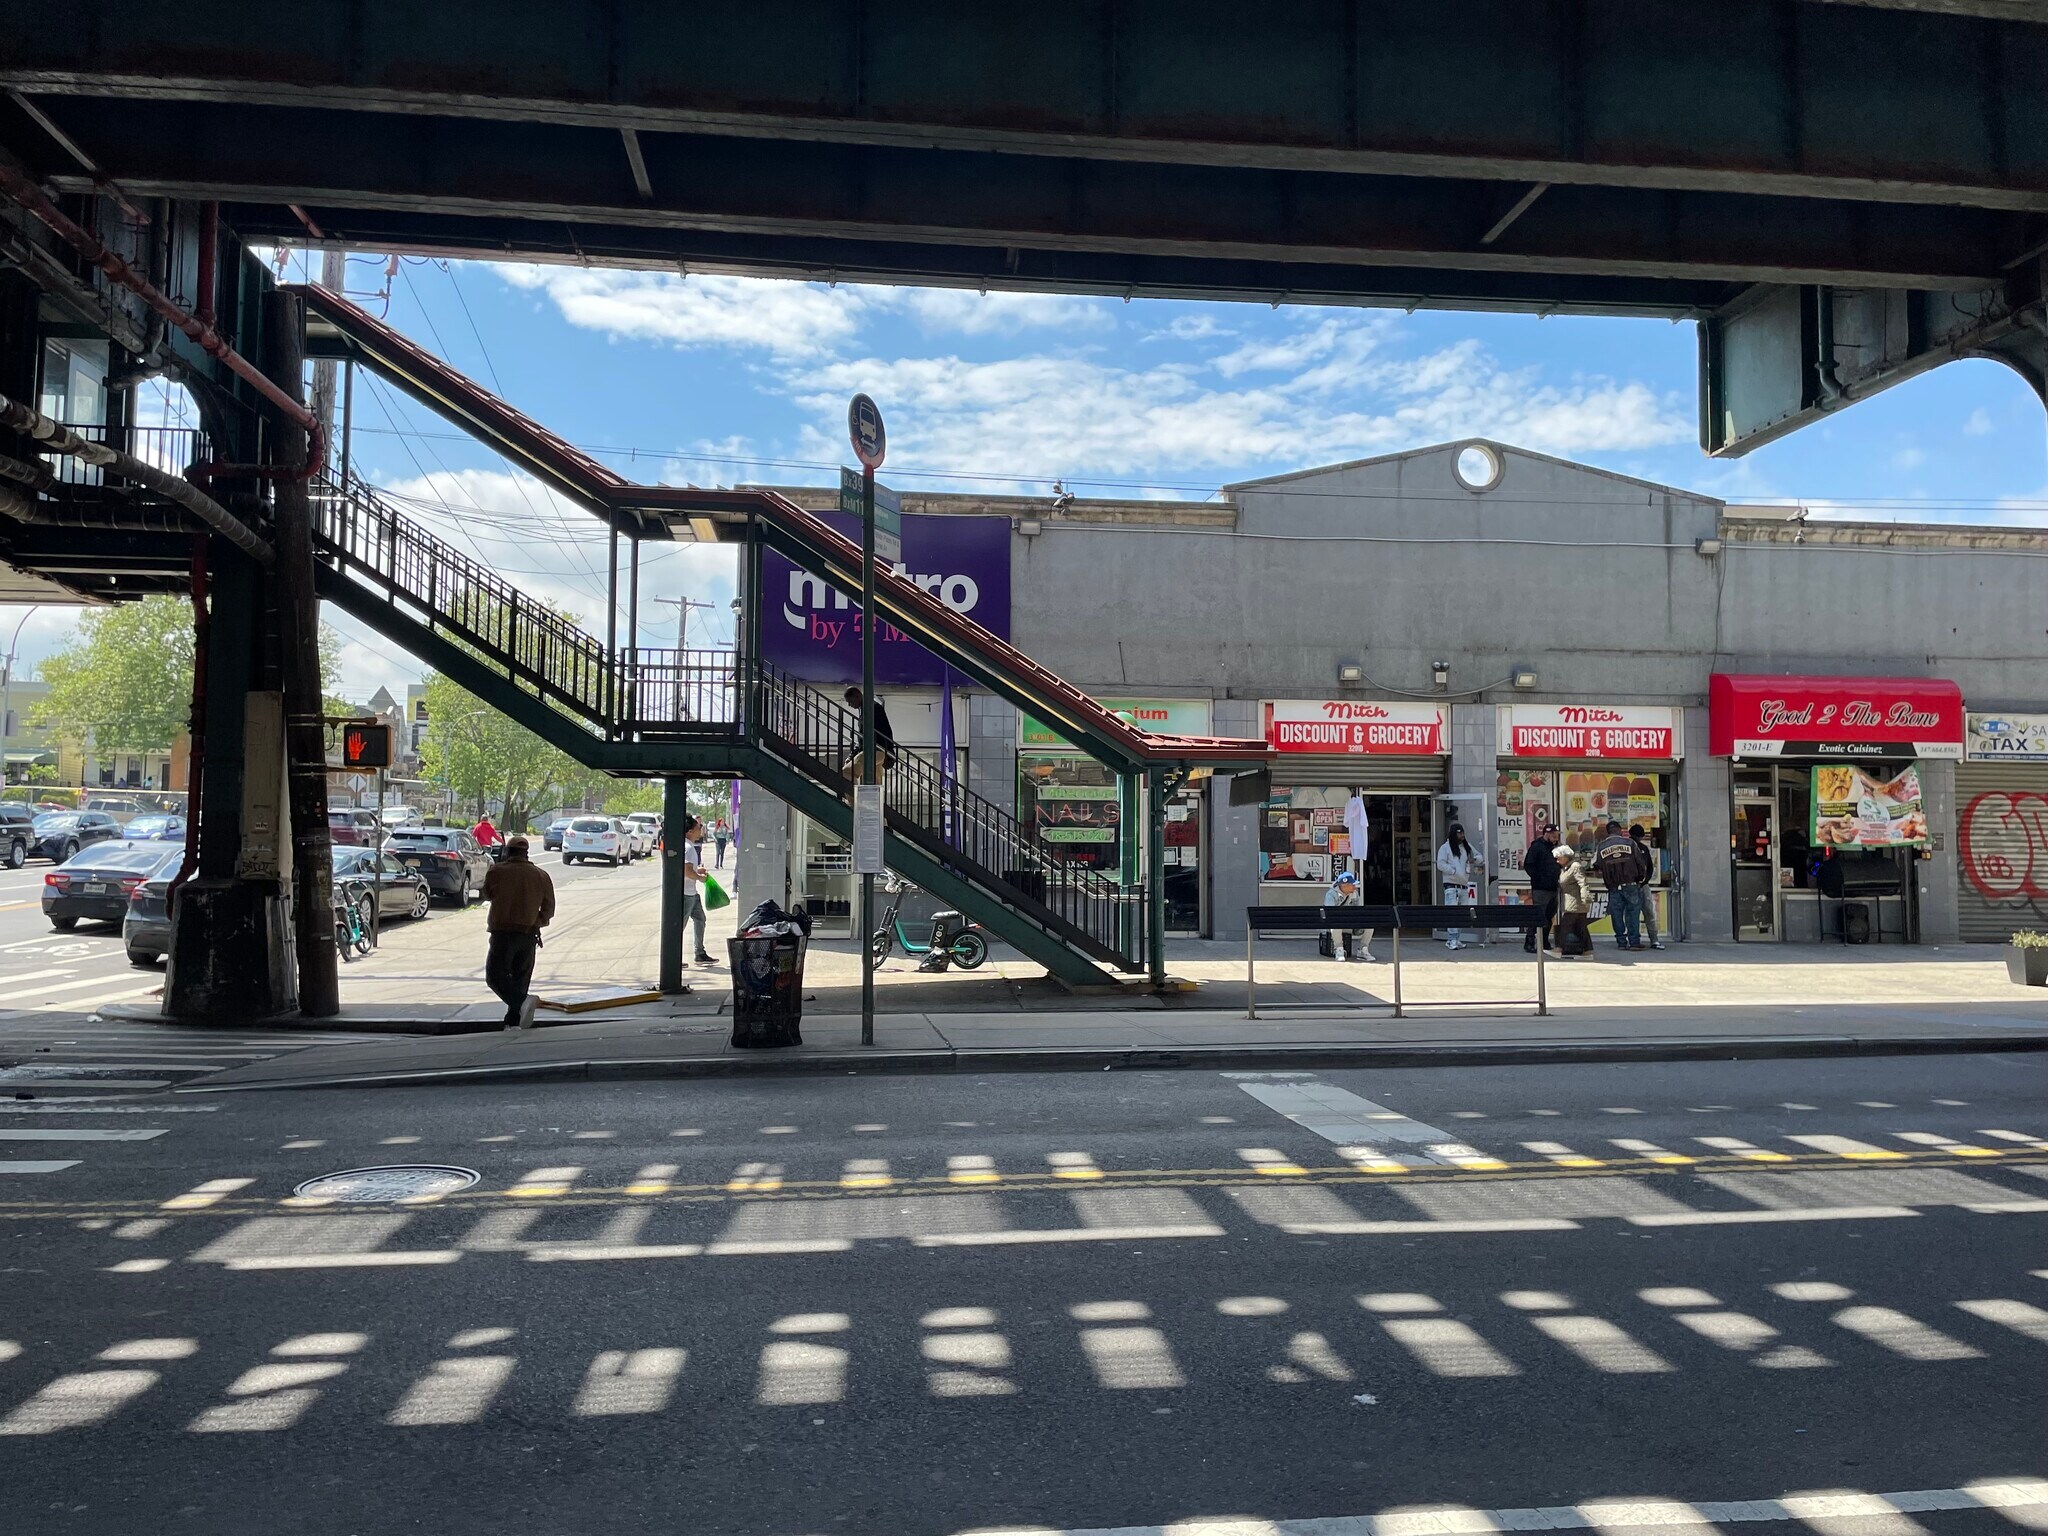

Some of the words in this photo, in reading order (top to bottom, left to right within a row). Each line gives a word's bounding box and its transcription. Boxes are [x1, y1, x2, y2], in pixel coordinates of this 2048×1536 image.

[843, 473, 863, 493] Bx39
[843, 495, 864, 515] BxM11
[811, 614, 846, 648] by
[1323, 702, 1389, 719] Mitch
[1559, 706, 1623, 723] Mitch
[1758, 700, 1814, 733] Good
[1817, 704, 1836, 724] 2
[1841, 701, 1881, 726] The
[1885, 701, 1939, 727] Bone
[1280, 724, 1349, 744] DISCOUNT
[1354, 725, 1364, 743] &
[1369, 725, 1431, 745] GROCERY
[1518, 728, 1586, 748] DISCOUNT
[1590, 731, 1600, 748] &
[1605, 730, 1667, 749] GROCERY
[1818, 743, 1846, 754] Exotic
[1847, 744, 1883, 755] Cuisinez
[1989, 737, 2028, 751] TAX
[2034, 738, 2046, 752] S
[1316, 815, 1333, 823] OPEN
[1498, 816, 1522, 826] hint
